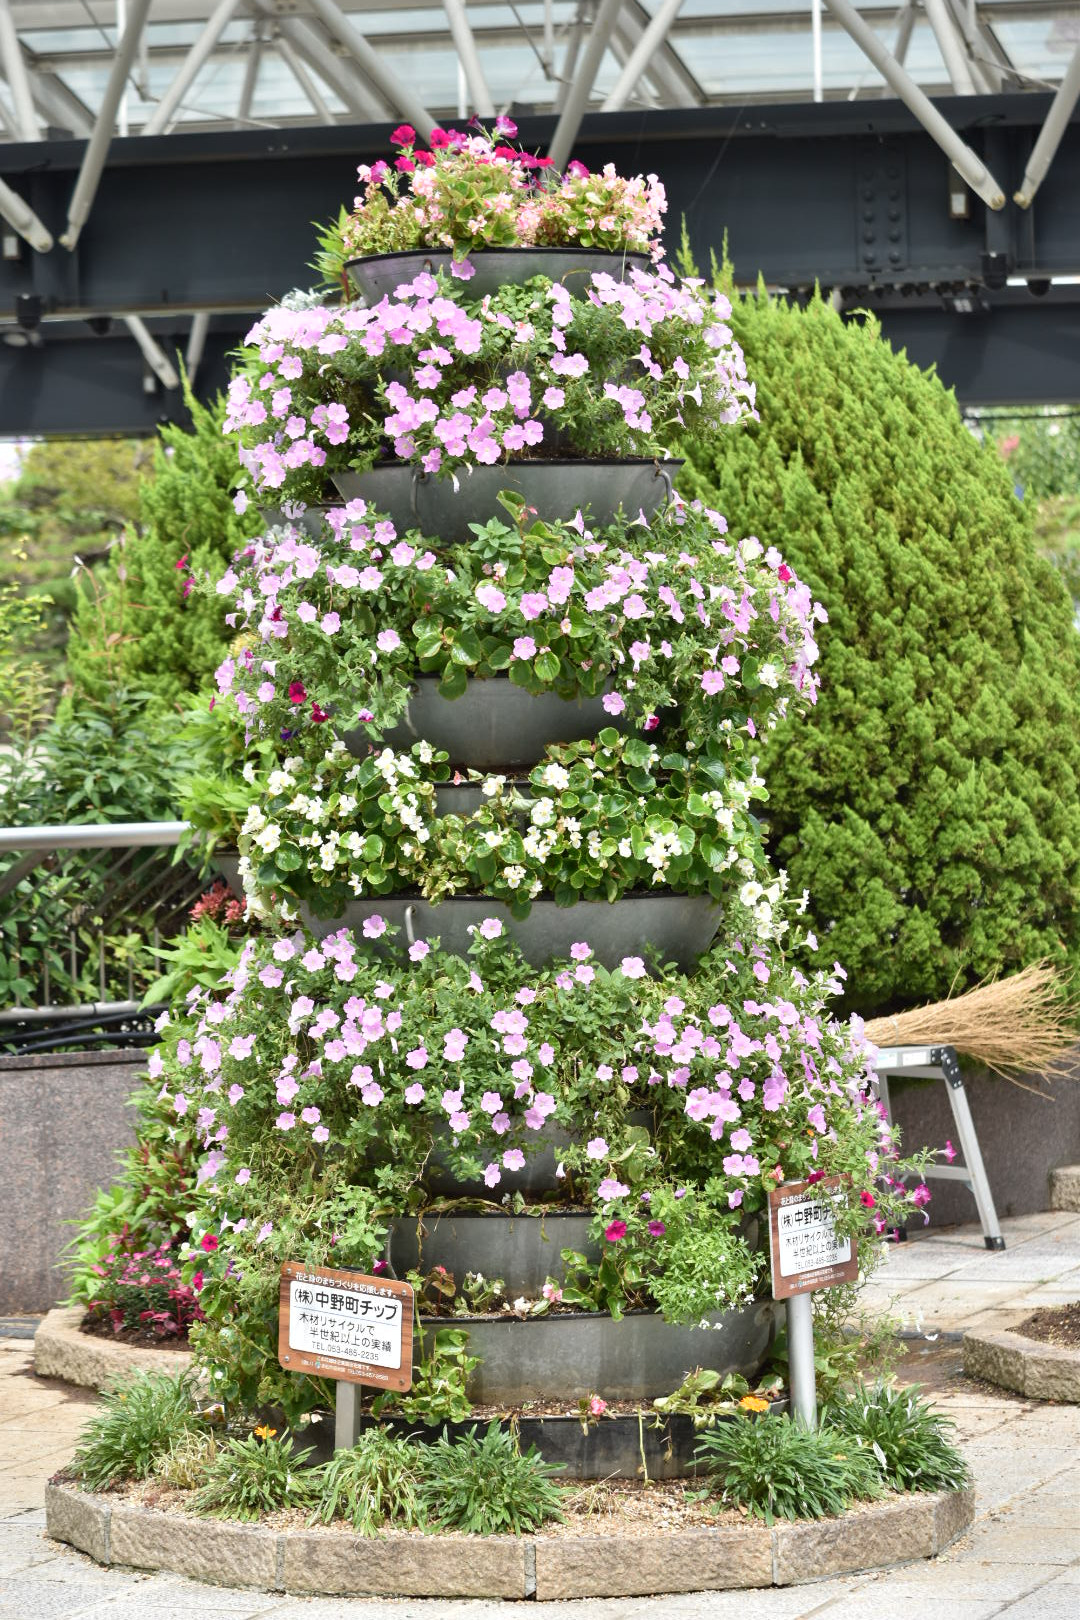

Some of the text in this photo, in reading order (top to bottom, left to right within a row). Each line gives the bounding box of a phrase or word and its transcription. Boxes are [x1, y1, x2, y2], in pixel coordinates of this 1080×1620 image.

[295, 1288, 398, 1320] (株)中野町チップ
[299, 1312, 375, 1336] 木材リサイクルで
[309, 1326, 392, 1352] 半世紀以上の実績
